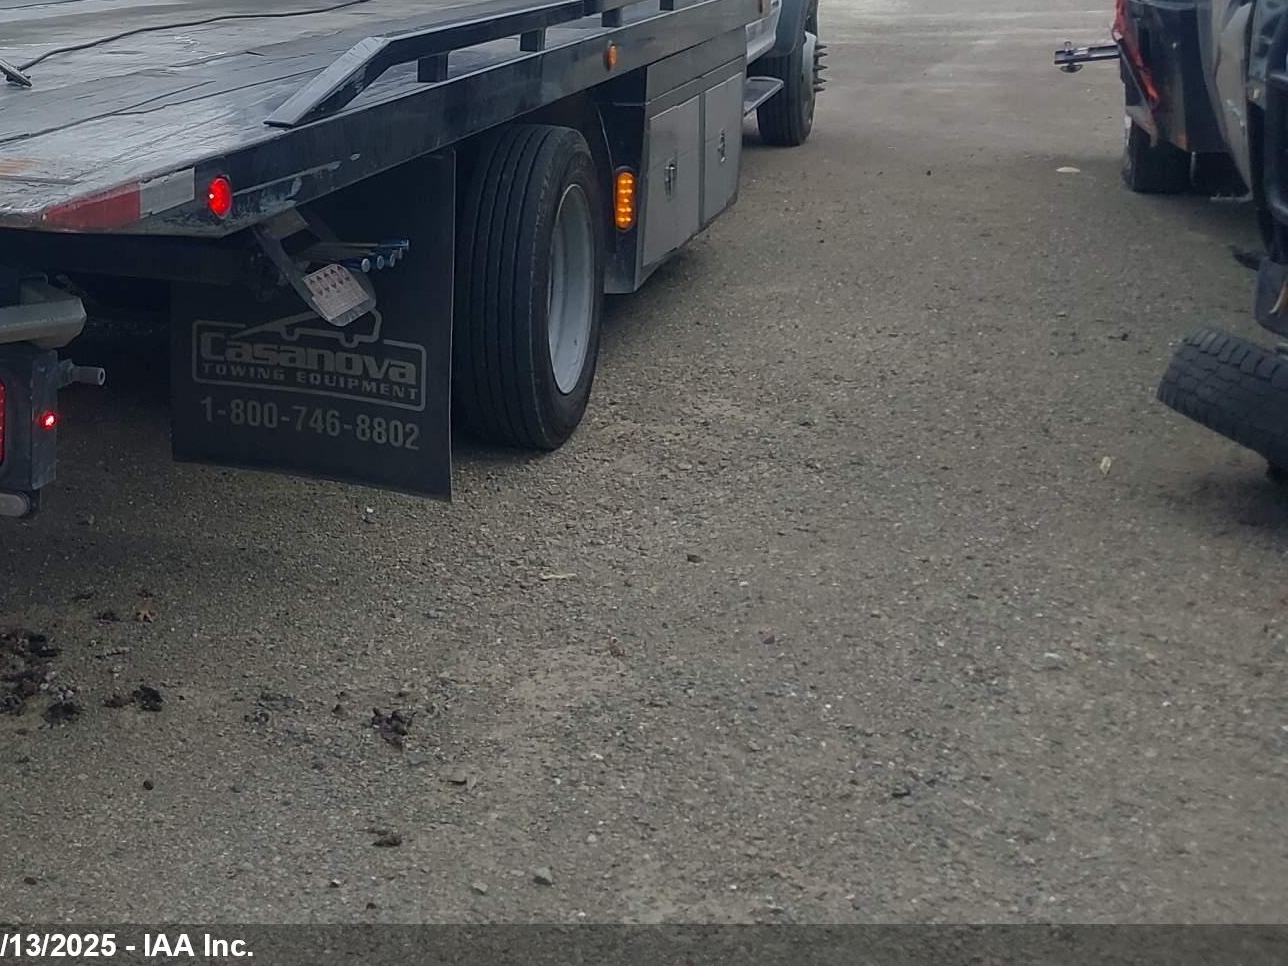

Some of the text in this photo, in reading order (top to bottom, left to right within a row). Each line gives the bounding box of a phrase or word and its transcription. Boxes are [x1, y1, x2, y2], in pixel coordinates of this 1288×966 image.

[200, 332, 417, 385] Casanova
[200, 363, 419, 400] TOWING EQUIPMENT
[199, 395, 420, 451] 1-800-746-8802
